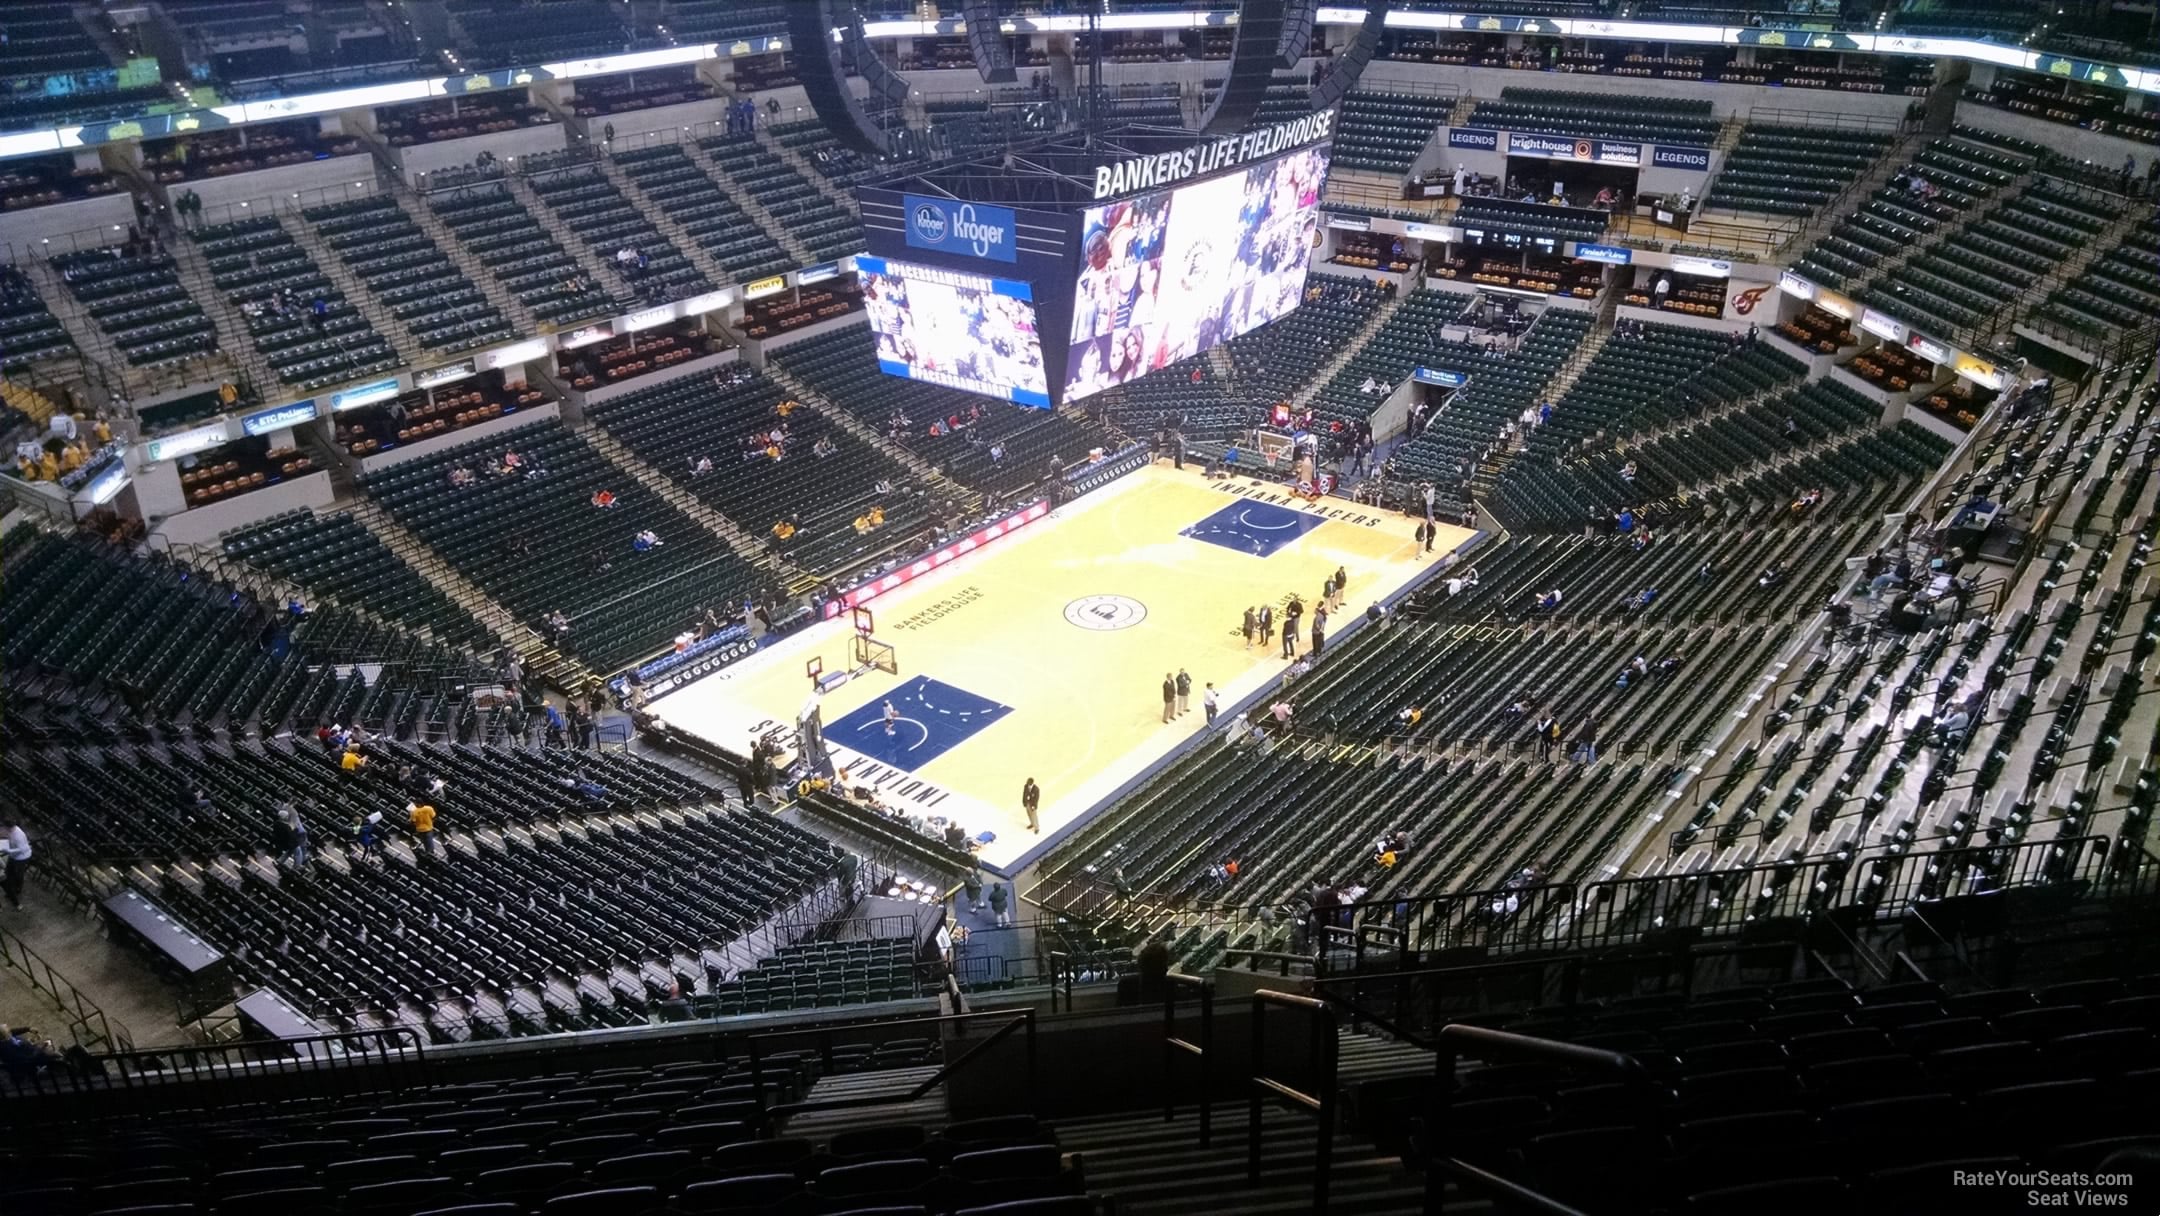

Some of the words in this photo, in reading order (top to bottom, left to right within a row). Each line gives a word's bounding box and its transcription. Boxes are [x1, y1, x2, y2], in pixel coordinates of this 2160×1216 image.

[1094, 150, 1195, 199] BANKERS
[1198, 137, 1239, 174] LIFE
[1238, 109, 1334, 163] FIELDHOUSE
[1451, 133, 1495, 146] LEGENDS
[1511, 138, 1541, 150] bright
[1541, 140, 1573, 152] house
[1602, 143, 1637, 154] business
[1601, 153, 1637, 162] solutions
[1655, 151, 1706, 166] LEGENDS
[917, 209, 944, 237] Kroger
[953, 204, 1004, 257] Kroger
[1211, 482, 1294, 505] INDIANA
[1302, 504, 1381, 527] PACERS
[893, 600, 952, 630] BANKERS
[952, 586, 979, 600] LIFE
[909, 592, 984, 630] FIELDHOUSE
[846, 757, 950, 807] INDIANA
